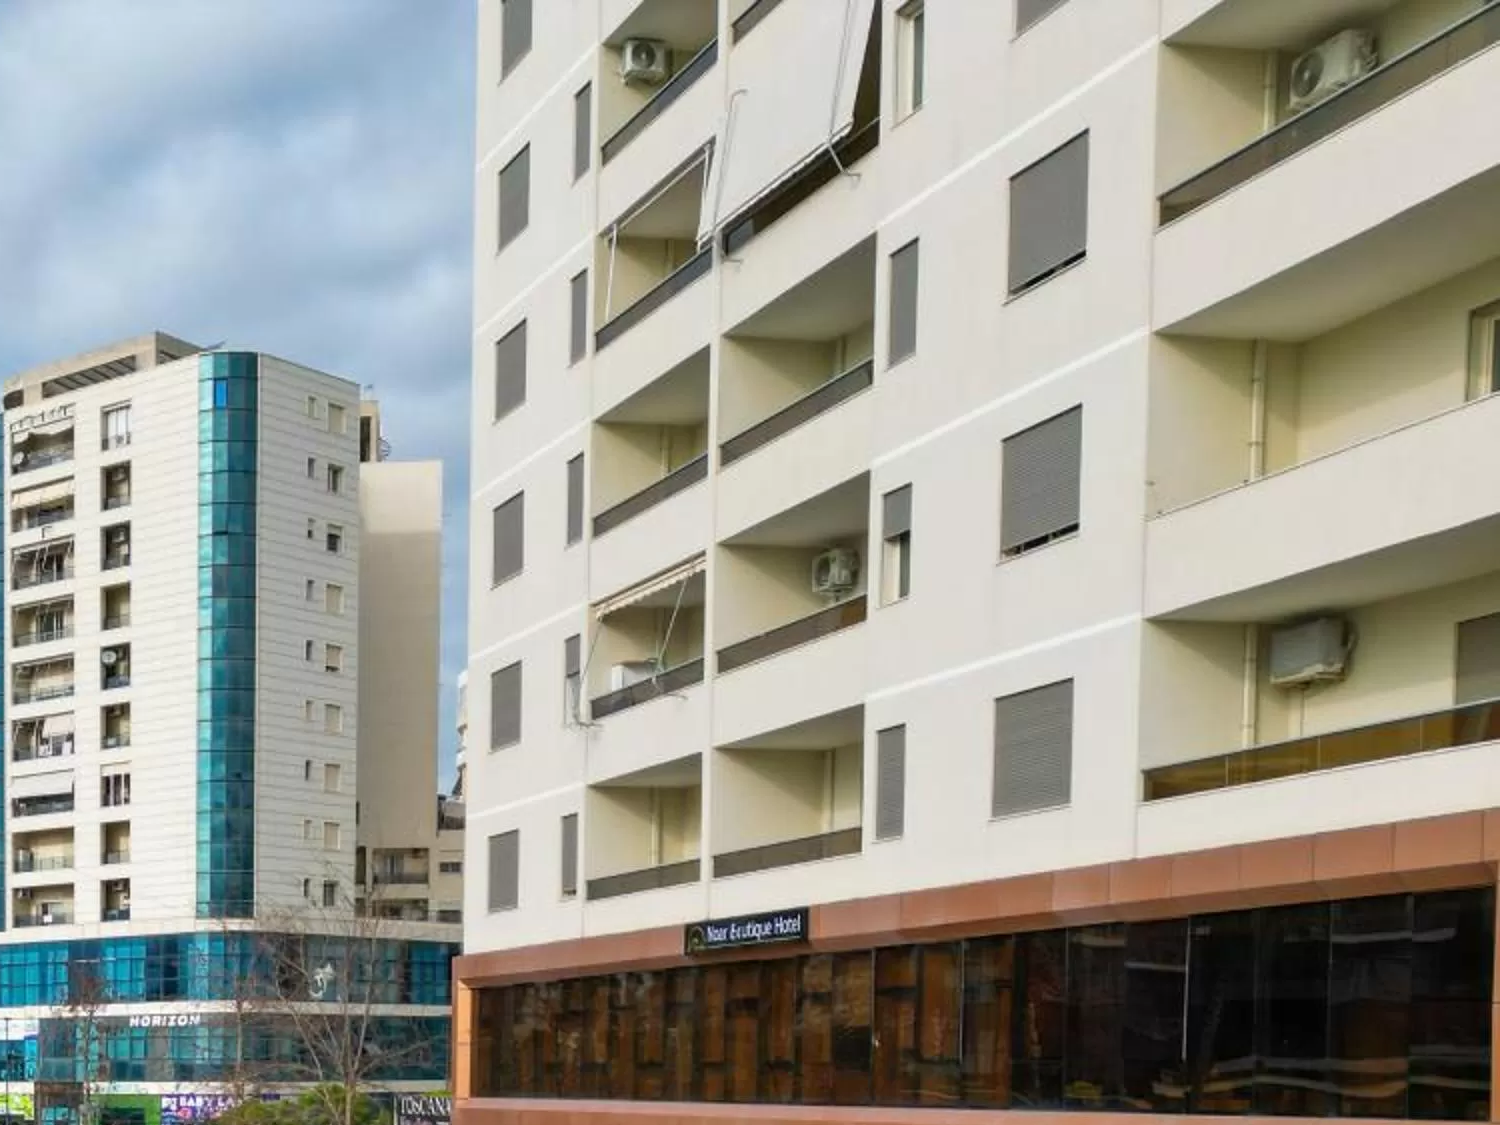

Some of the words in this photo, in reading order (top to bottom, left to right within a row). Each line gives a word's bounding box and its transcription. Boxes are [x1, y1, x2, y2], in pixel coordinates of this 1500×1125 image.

[773, 913, 801, 934] Hotel
[129, 1014, 201, 1027] HORIZON
[180, 1096, 214, 1107] BABY
[398, 1094, 451, 1116] TOSCANA
